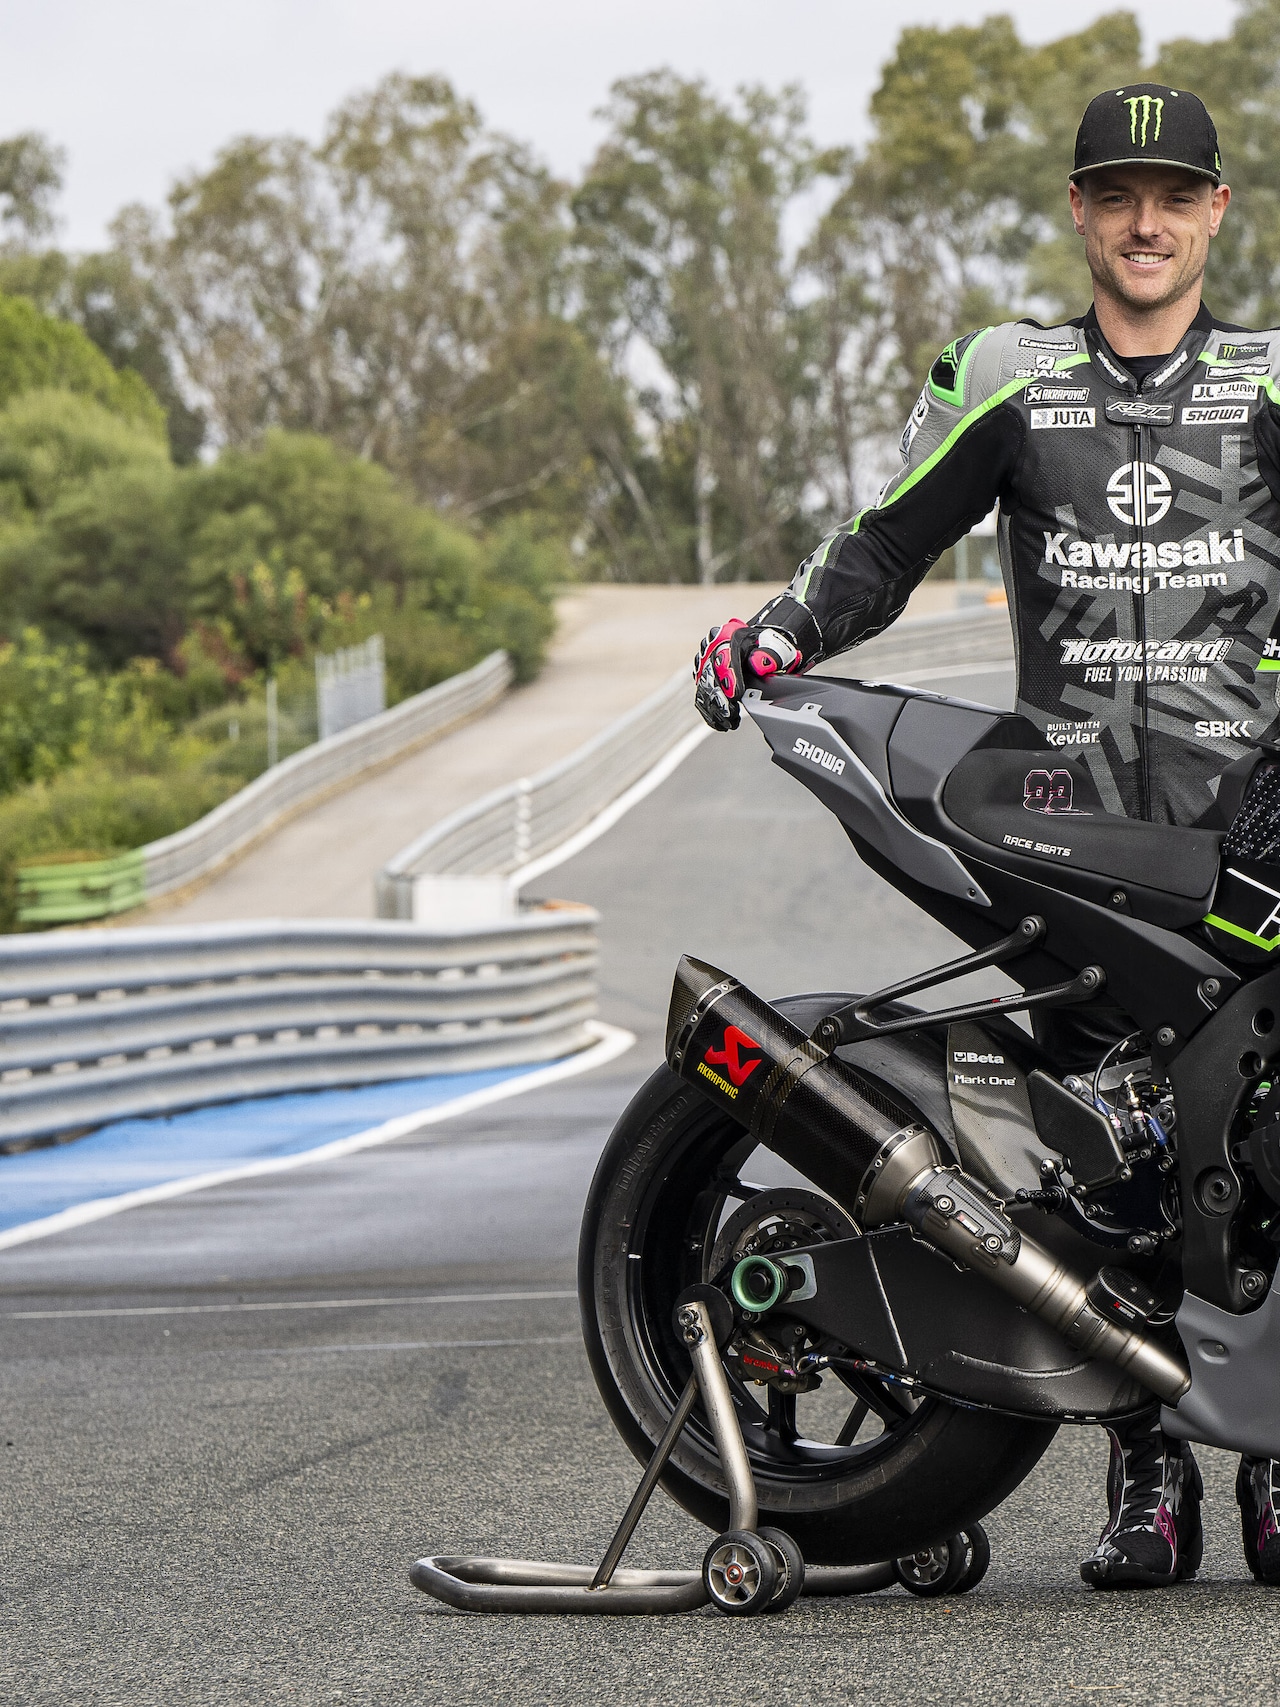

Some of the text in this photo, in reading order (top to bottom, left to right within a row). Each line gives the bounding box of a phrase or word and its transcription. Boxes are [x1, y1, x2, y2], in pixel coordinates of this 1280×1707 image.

[1020, 338, 1076, 350] Kawasaki
[1014, 368, 1073, 380] SHARK
[1052, 410, 1092, 425] JUTA
[1185, 408, 1245, 421] SHOWA
[1043, 528, 1245, 568] Kawasaki
[1060, 569, 1228, 594] Racing Team
[1084, 666, 1113, 683] FUEL
[1154, 666, 1208, 683] PASSION
[1047, 720, 1100, 732] BUILT WITH
[791, 736, 847, 776] SHOWA
[1002, 834, 1072, 858] RACE SEATS
[966, 1052, 1005, 1065] Beta
[954, 1074, 1016, 1086] Mark One
[743, 1353, 780, 1374] brembo
